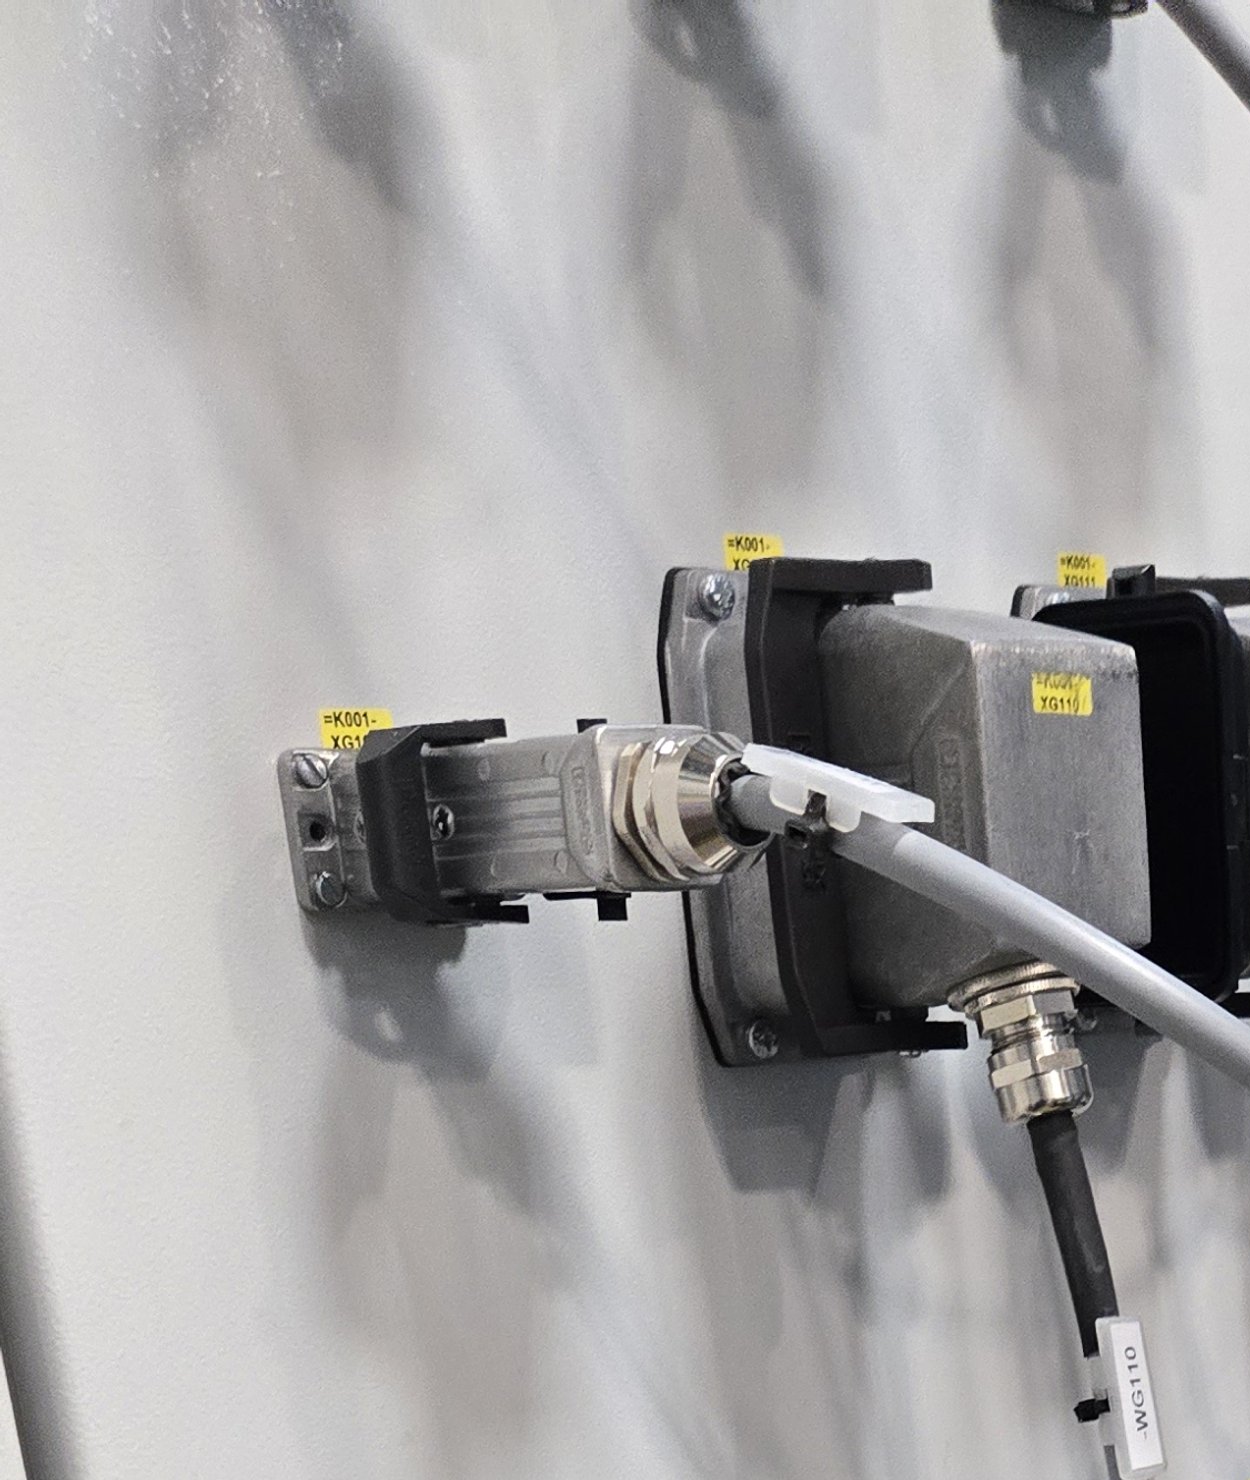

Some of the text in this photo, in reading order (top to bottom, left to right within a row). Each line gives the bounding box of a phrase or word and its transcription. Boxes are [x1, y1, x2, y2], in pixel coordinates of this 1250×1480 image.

[728, 536, 771, 552] =K001-
[324, 711, 378, 728] =K001-
[331, 734, 367, 750] XG1
[1124, 1346, 1148, 1441] -WG110
